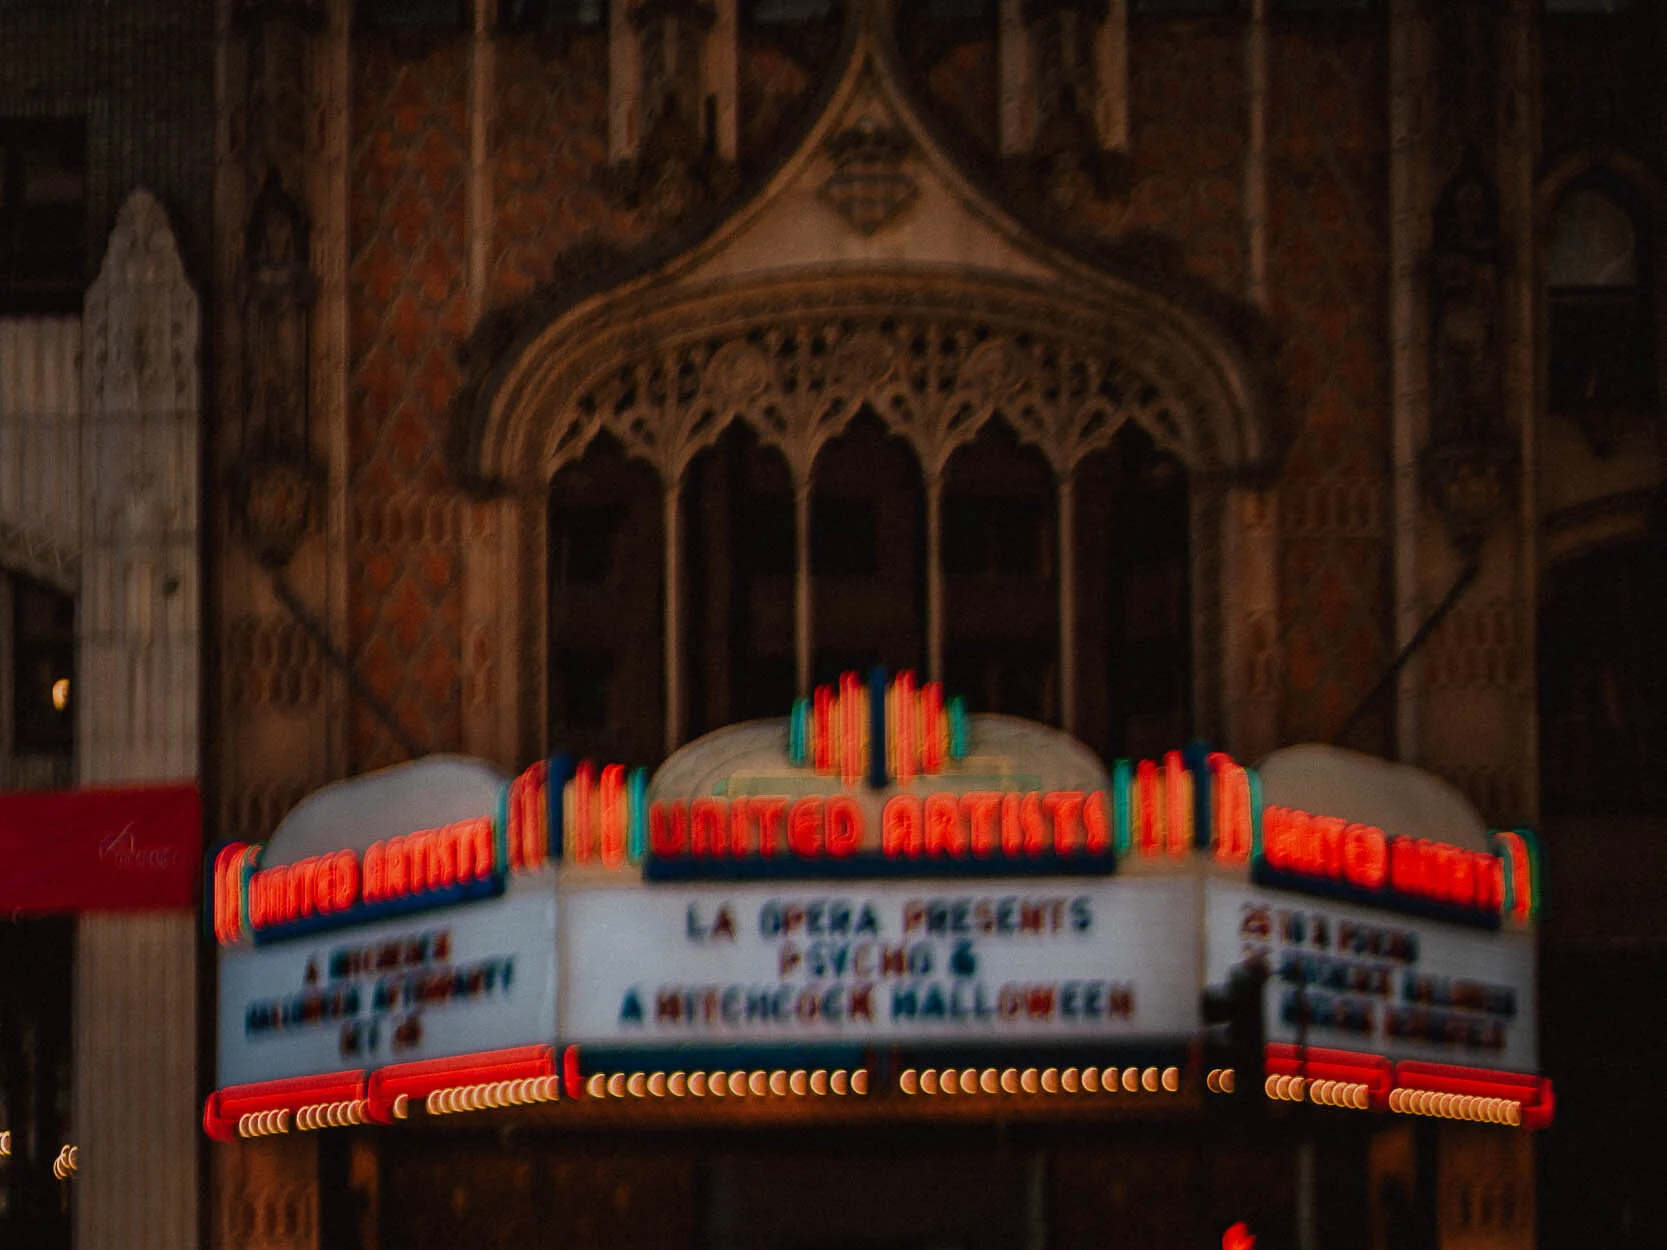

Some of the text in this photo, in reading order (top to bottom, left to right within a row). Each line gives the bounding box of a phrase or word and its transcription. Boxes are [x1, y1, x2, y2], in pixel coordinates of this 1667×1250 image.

[649, 791, 1106, 857] UNITED ARTISTS
[687, 895, 1093, 940] LA OPERA PRESENTS
[779, 941, 932, 978] PSYCHO
[620, 982, 1135, 1026] A HITCHCOCK HALLOWEEN
